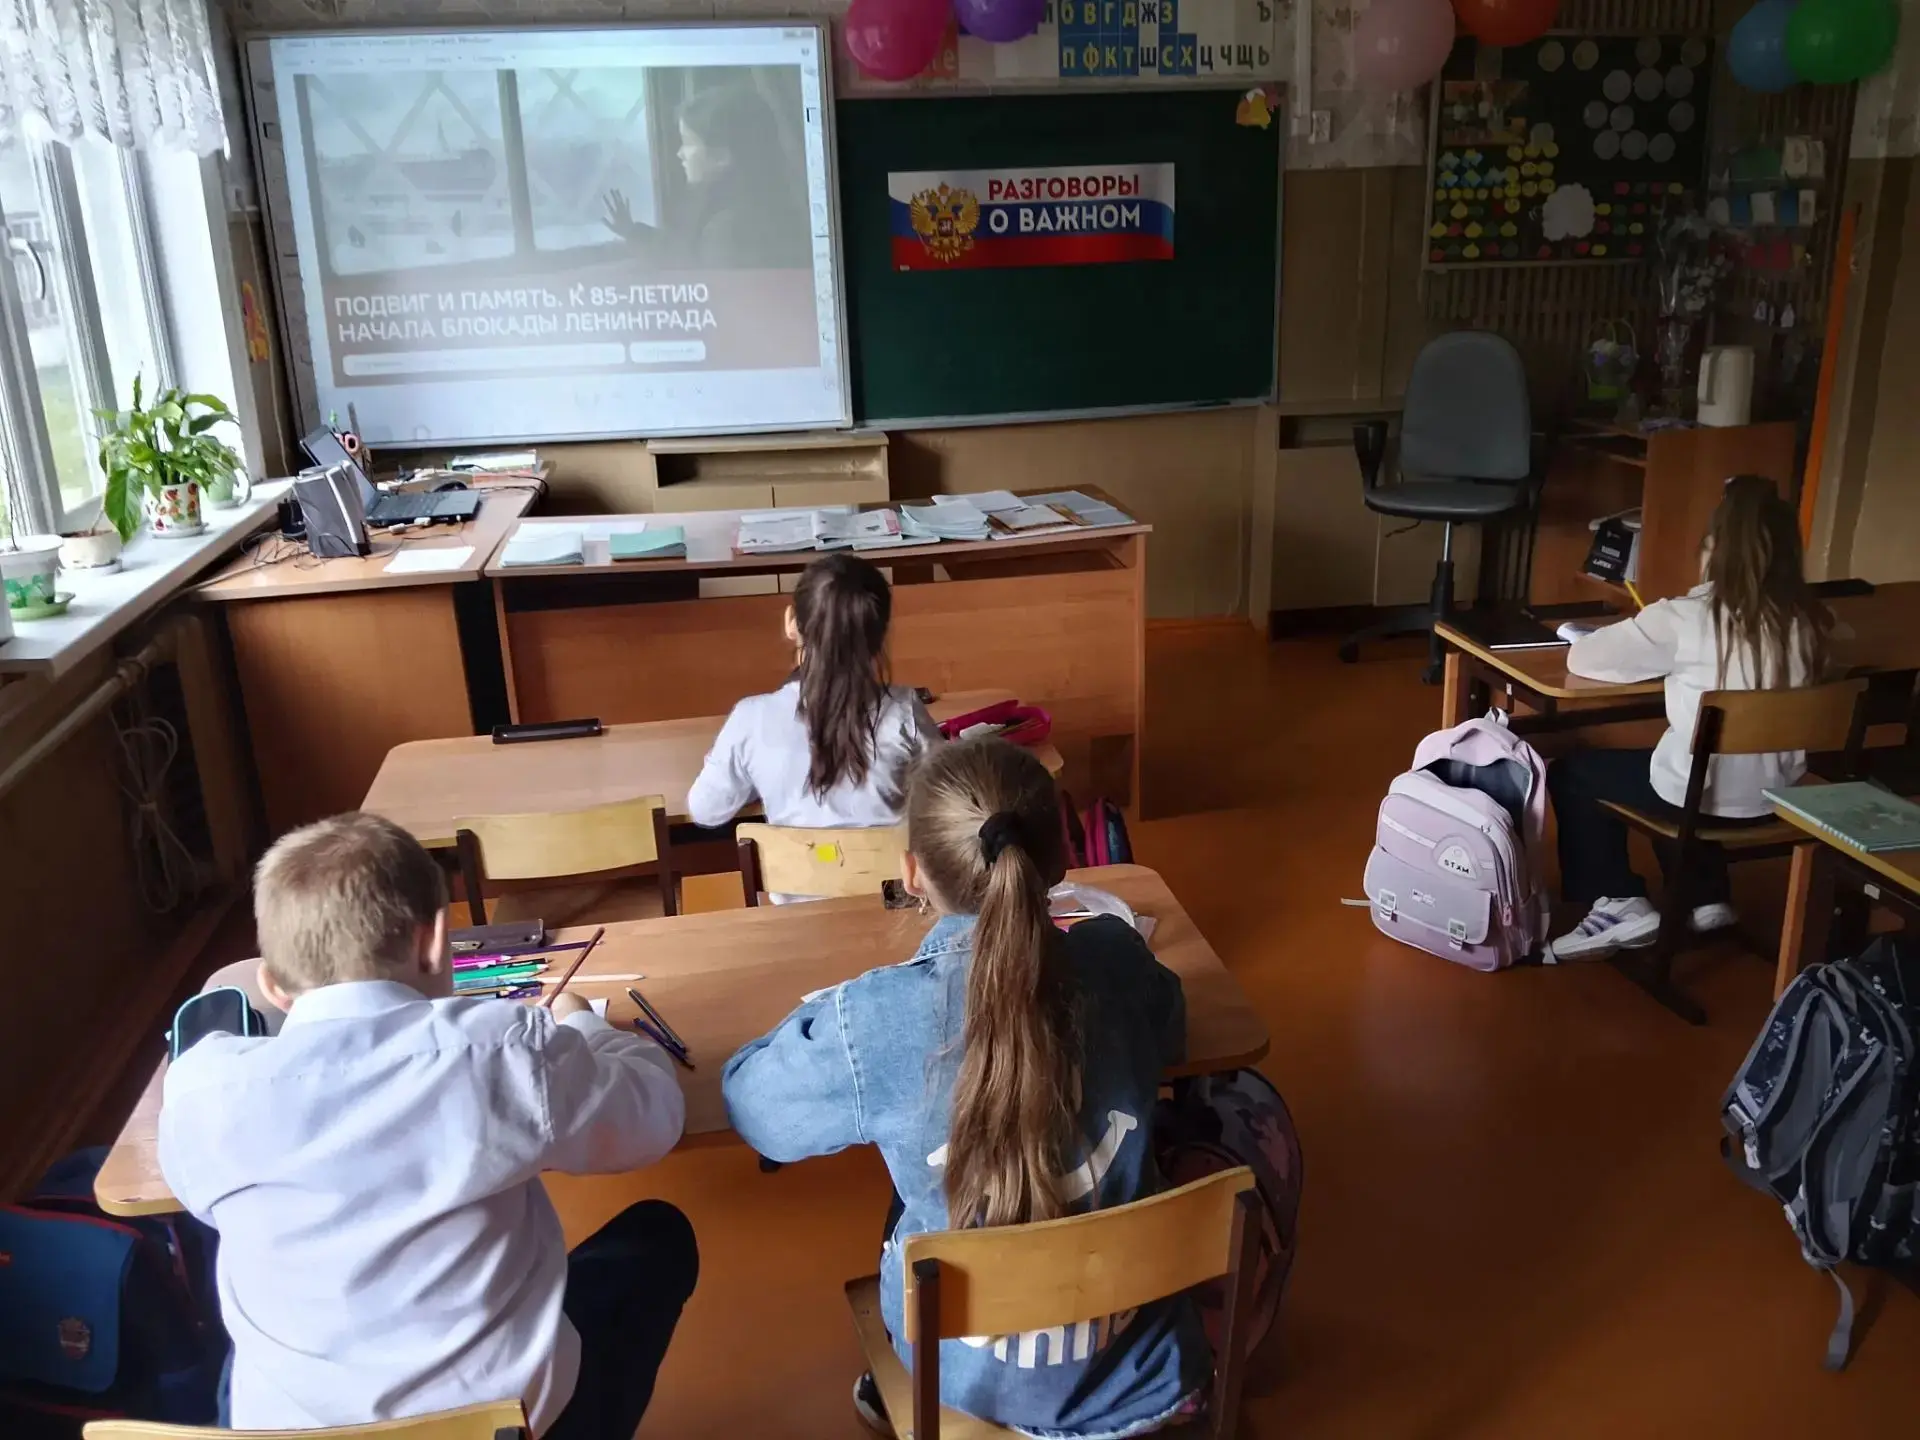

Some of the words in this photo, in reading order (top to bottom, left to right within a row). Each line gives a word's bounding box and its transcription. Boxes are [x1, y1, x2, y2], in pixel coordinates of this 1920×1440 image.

[988, 174, 1139, 201] РАЗГОВОРЫ
[989, 208, 1009, 234] О
[1019, 203, 1140, 232] ВАЖНОМ
[334, 292, 431, 318] ПОДВИГ
[438, 292, 454, 312] И
[461, 287, 563, 311] ПАМЯТЬ.
[569, 287, 584, 308] К
[590, 283, 709, 306] 85-ЛЕТИЮ
[338, 319, 436, 343] НАЧАЛА
[441, 314, 558, 337] БЛОКАДЫ
[565, 308, 717, 332] ЛЕНИНГРАДА
